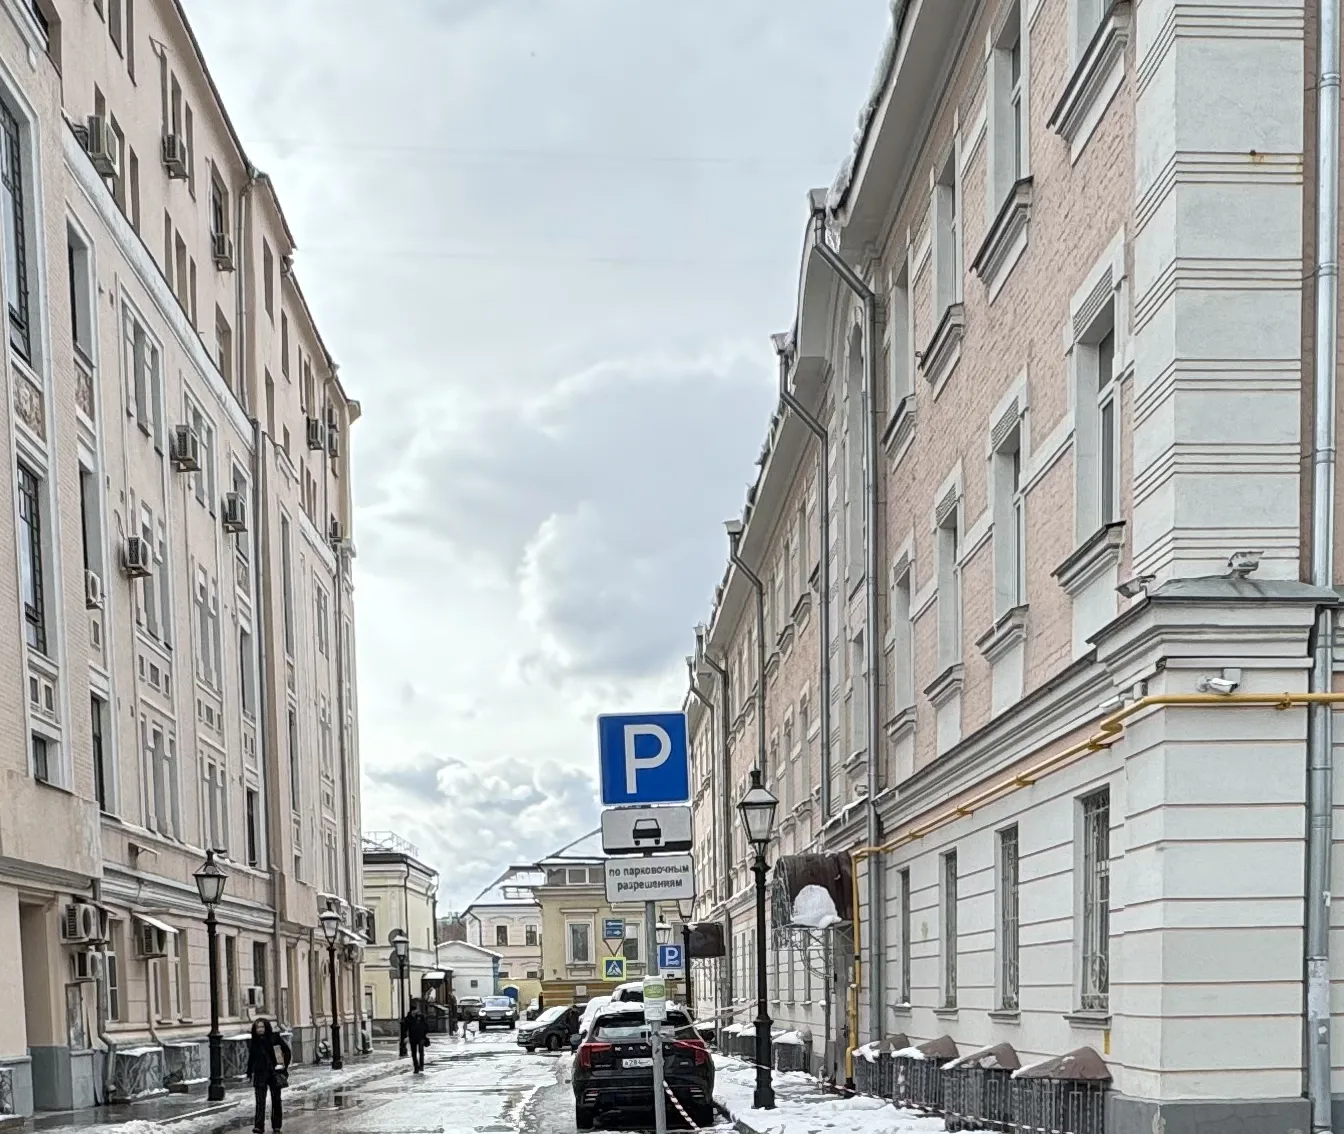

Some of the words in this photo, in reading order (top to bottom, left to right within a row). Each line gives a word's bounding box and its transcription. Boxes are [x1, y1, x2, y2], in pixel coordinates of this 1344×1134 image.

[623, 723, 672, 794] P
[608, 867, 621, 876] по
[623, 865, 689, 878] парковочным
[617, 879, 683, 893] разрешениям
